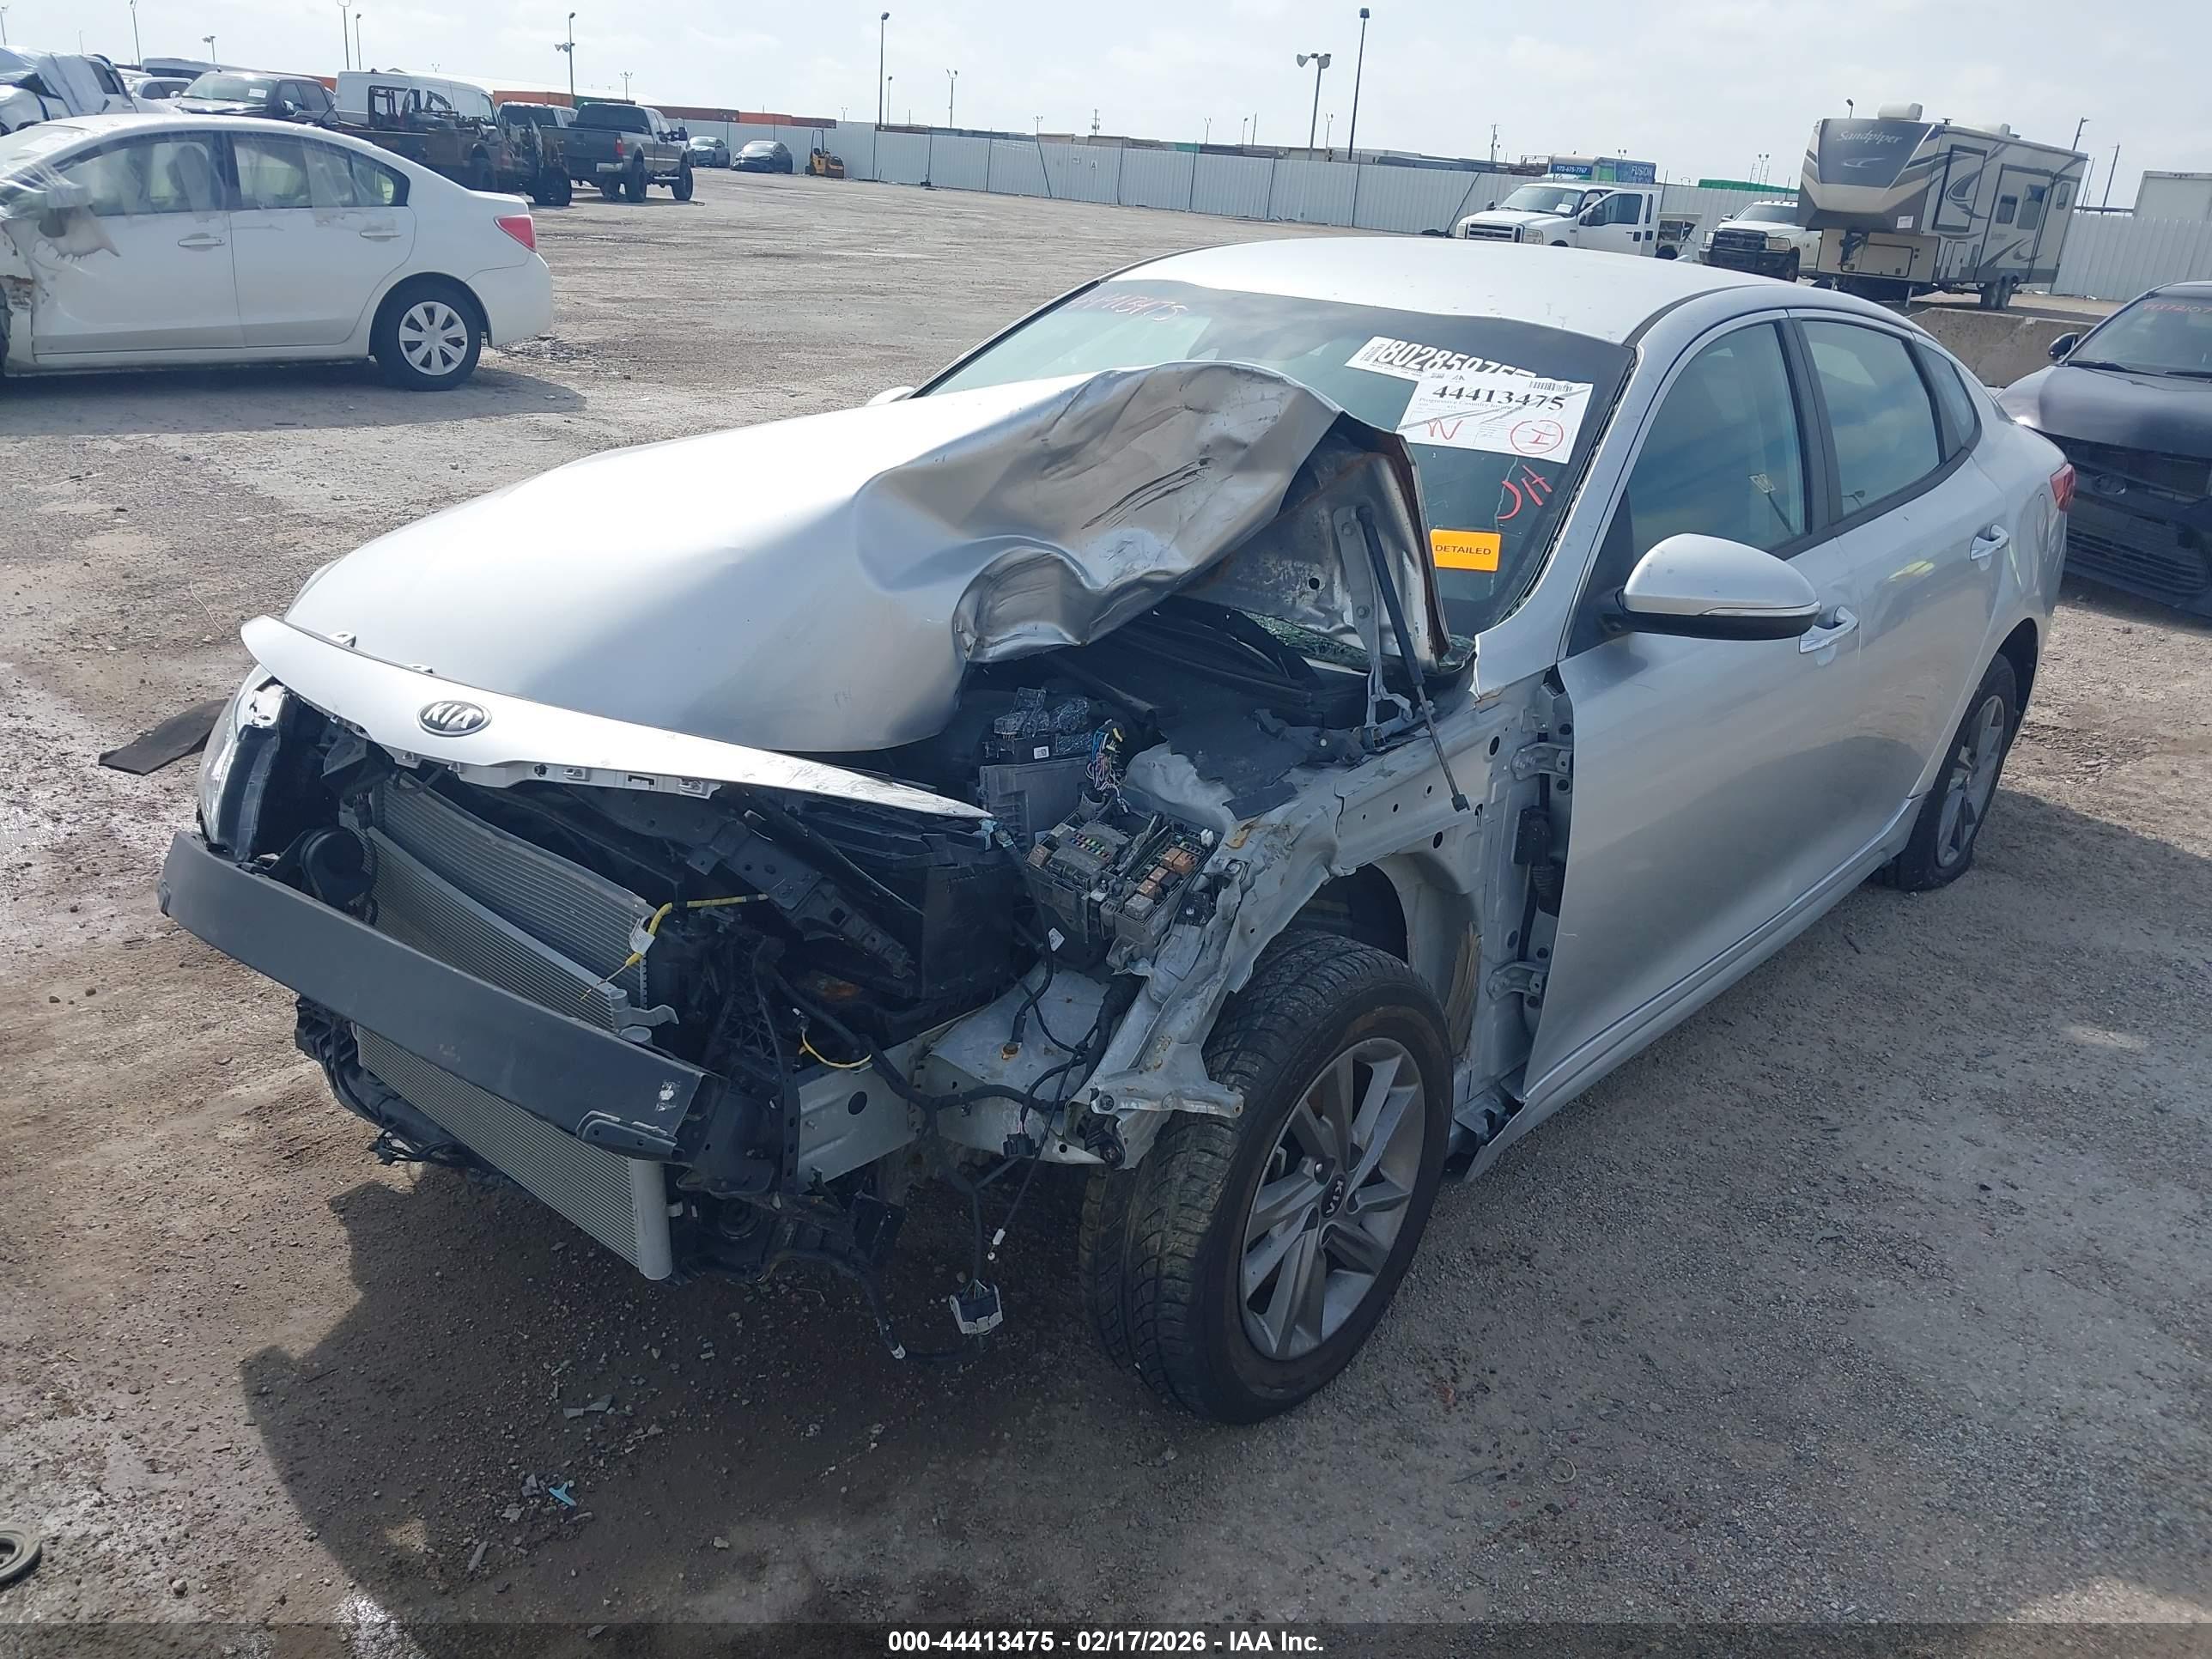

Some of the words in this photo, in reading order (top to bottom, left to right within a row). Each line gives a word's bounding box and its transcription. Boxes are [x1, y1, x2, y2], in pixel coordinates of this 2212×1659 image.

[1837, 131, 1903, 144] Sandpiper
[1432, 385, 1566, 411] 44413475
[1435, 544, 1492, 556] DETAILED
[423, 702, 483, 729] KIA
[1325, 1180, 1344, 1214] KIA
